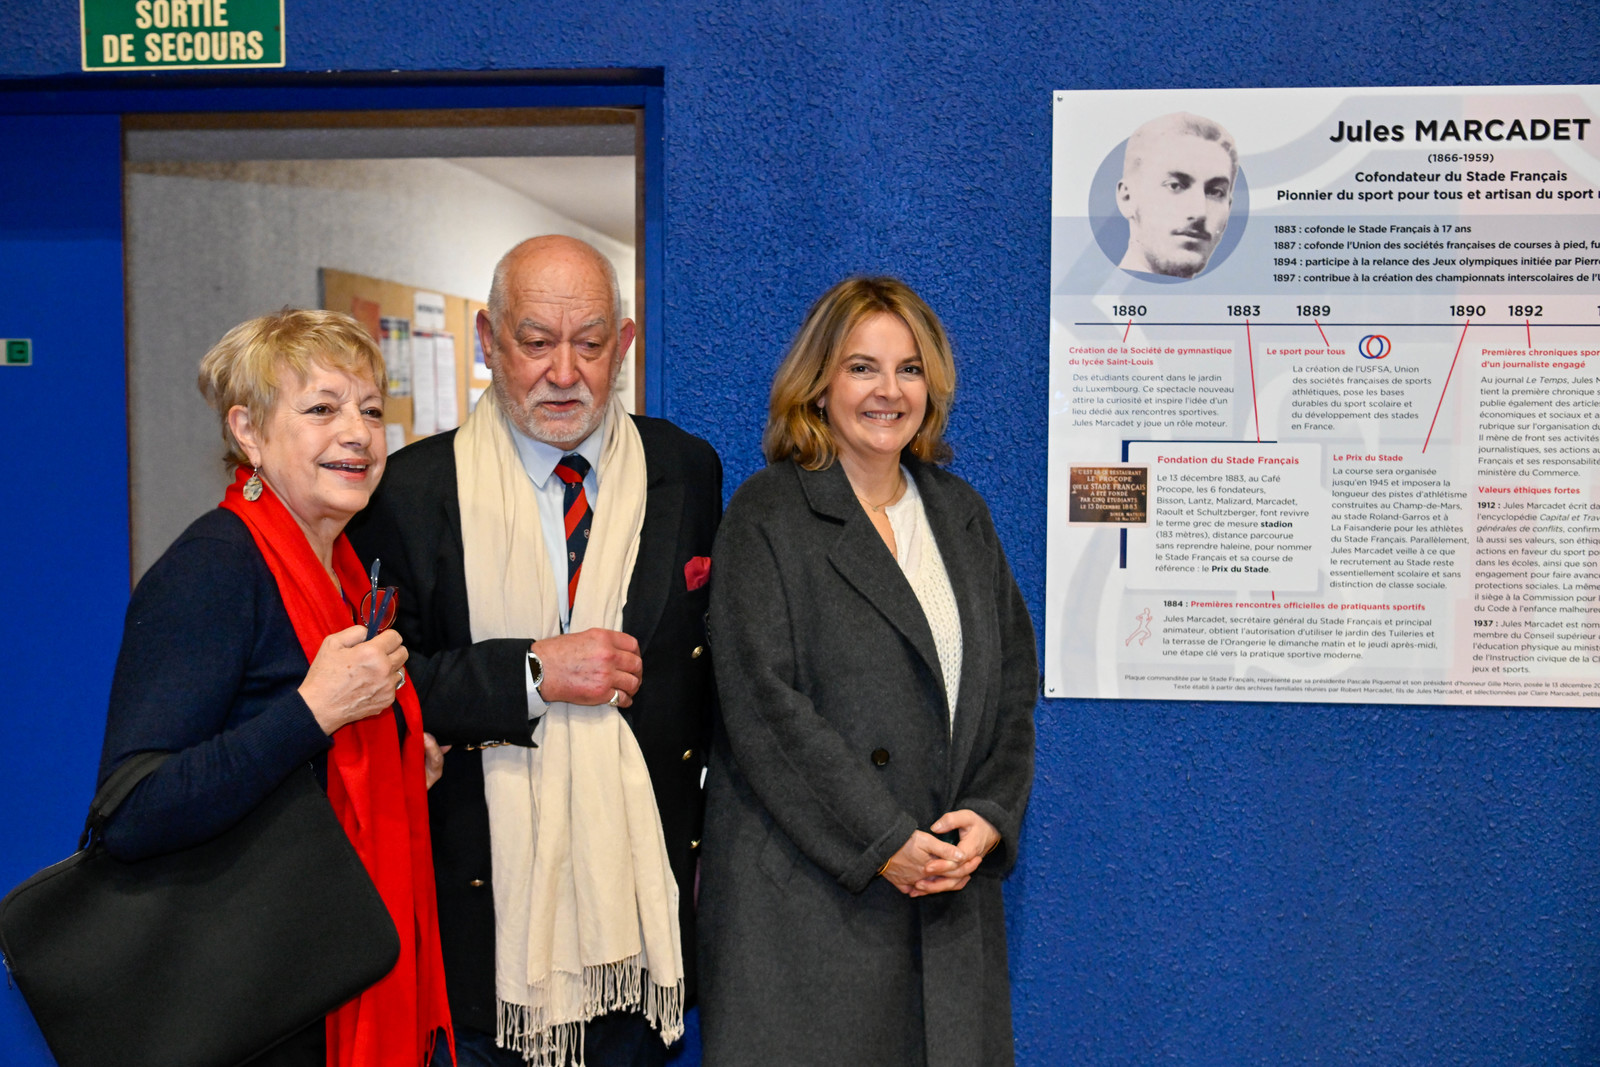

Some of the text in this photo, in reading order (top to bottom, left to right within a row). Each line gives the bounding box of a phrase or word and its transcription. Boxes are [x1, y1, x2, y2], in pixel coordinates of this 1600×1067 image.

[135, 0, 228, 29] SORTIE
[102, 31, 264, 63] DE SECOURS
[1330, 119, 1591, 140] Jules MARCADET
[1428, 154, 1494, 163] (1866-1959)
[1355, 171, 1567, 183] Cofondateur du Stade Français
[1277, 189, 1332, 200] Pionnier
[1337, 190, 1353, 200] du
[1358, 190, 1393, 202] sport
[1398, 192, 1430, 202] pour
[1434, 190, 1463, 200] tous
[1467, 190, 1481, 199] et
[1485, 189, 1531, 199] artisan
[1536, 188, 1553, 199] du
[1558, 189, 1594, 201] sport
[1304, 225, 1344, 233] cofonde
[1348, 225, 1356, 233] le
[1359, 225, 1387, 233] Stade
[1390, 225, 1430, 234] Français
[1433, 225, 1439, 233] à
[1304, 241, 1344, 249] cofonde
[1347, 241, 1381, 249] l'Union
[1384, 241, 1401, 249] des
[1404, 241, 1444, 249] sociétés
[1446, 241, 1496, 250] françaises
[1498, 241, 1511, 249] de
[1554, 241, 1560, 249] à
[1563, 241, 1588, 250] pied,
[1274, 258, 1297, 266] 1894
[1306, 258, 1350, 267] participe
[1352, 257, 1358, 266] à
[1361, 258, 1370, 266] la
[1373, 258, 1409, 266] relance
[1412, 258, 1430, 266] des
[1432, 258, 1456, 266] Jeux
[1459, 257, 1518, 267] olympiques
[1521, 257, 1552, 265] initiée
[1273, 274, 1296, 282] 1897
[1304, 274, 1350, 282] contribue
[1353, 274, 1358, 282] à
[1362, 274, 1370, 282] la
[1372, 274, 1413, 282] création
[1416, 274, 1433, 282] des
[1436, 274, 1505, 283] championnats
[1508, 274, 1574, 282] interscolaires
[1113, 305, 1543, 316] 1880 1883 1889 1890 1892
[1177, 347, 1232, 355] gymnastique
[1280, 348, 1302, 356] sport
[1327, 347, 1345, 355] tous
[1528, 349, 1578, 357] chroniques
[1503, 361, 1550, 369] journaliste
[1552, 361, 1586, 369] engagé
[1158, 456, 1299, 465] Fondation du Stade Français
[1514, 487, 1552, 495] éthiques
[1393, 502, 1462, 510] Champ-de-Mars,
[1236, 600, 1281, 608] rencontres
[1341, 603, 1390, 611] pratiquants
[1393, 603, 1425, 611] sportifs
[1472, 665, 1489, 673] jeux
